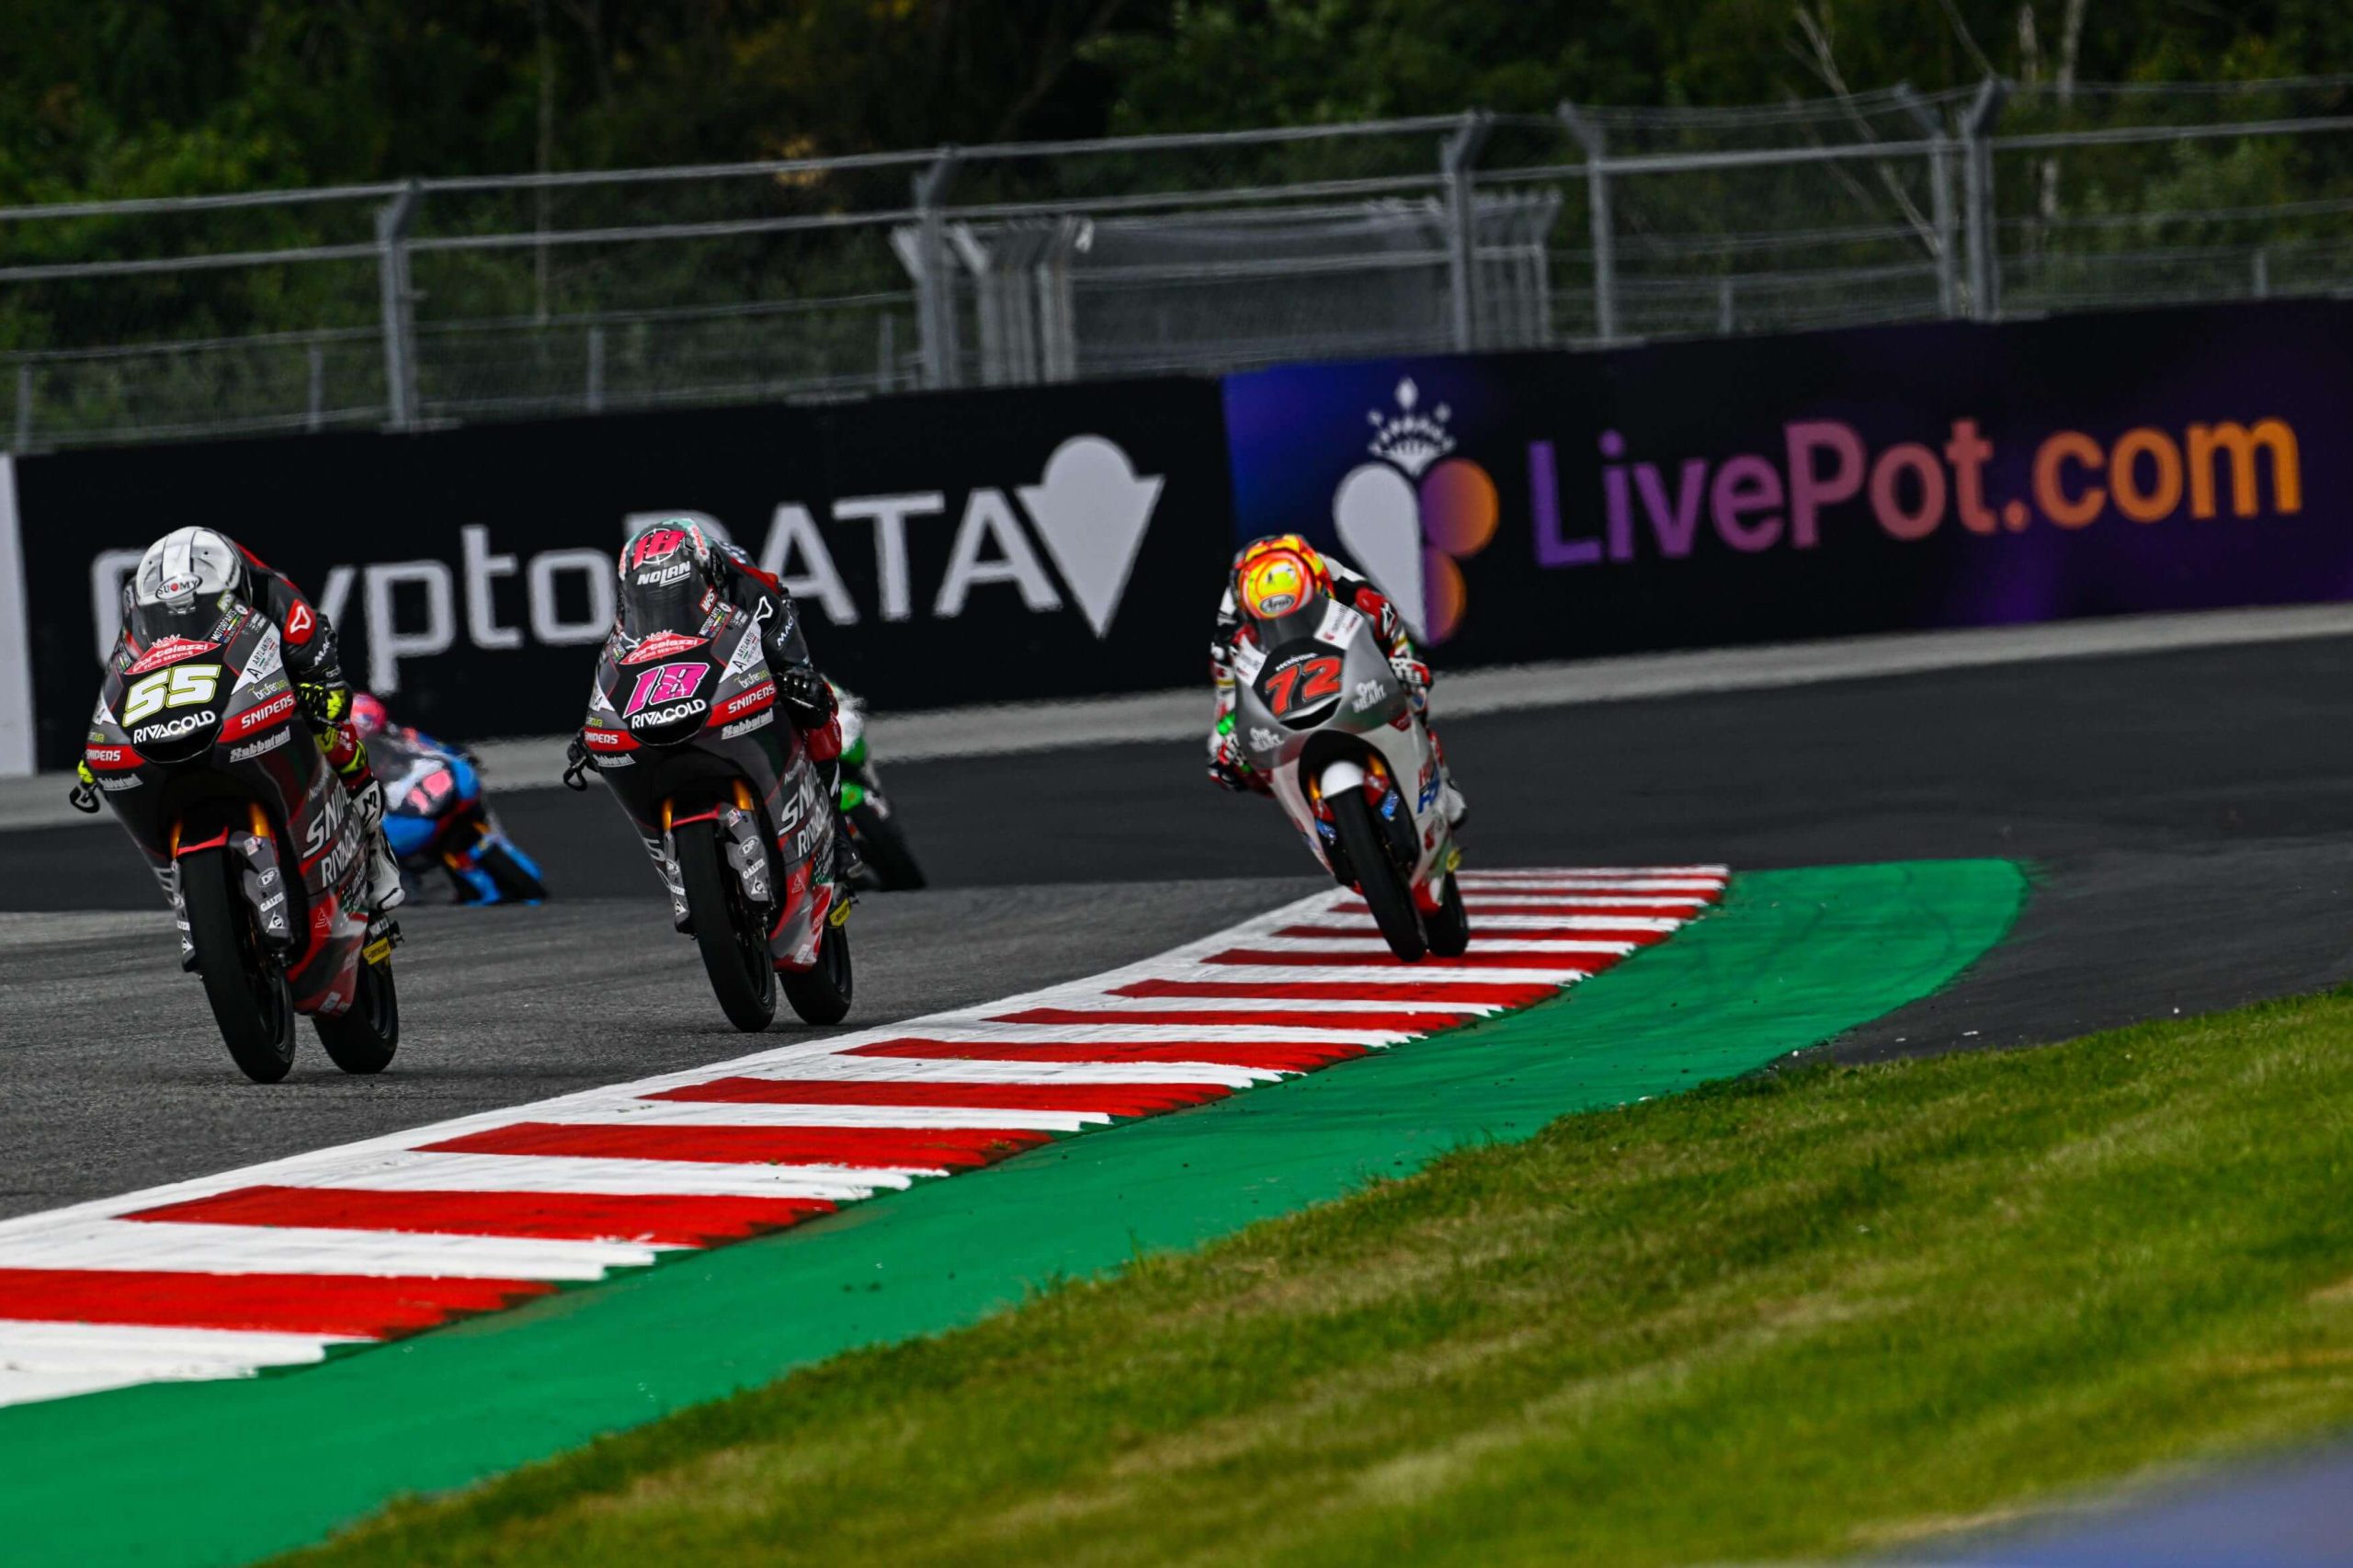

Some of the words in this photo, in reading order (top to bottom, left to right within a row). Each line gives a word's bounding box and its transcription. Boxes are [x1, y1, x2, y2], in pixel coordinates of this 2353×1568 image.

[1528, 416, 2304, 569] LivePot.com
[632, 529, 687, 571] 18
[636, 561, 691, 587] NOLAN
[121, 664, 222, 728] 55
[622, 662, 710, 720] 18
[727, 684, 777, 714] SNIPERS
[1265, 656, 1344, 720] 72
[132, 709, 217, 744] RIVACOLD
[240, 694, 295, 730] SNIPERS
[631, 699, 707, 729] RIVACOLD
